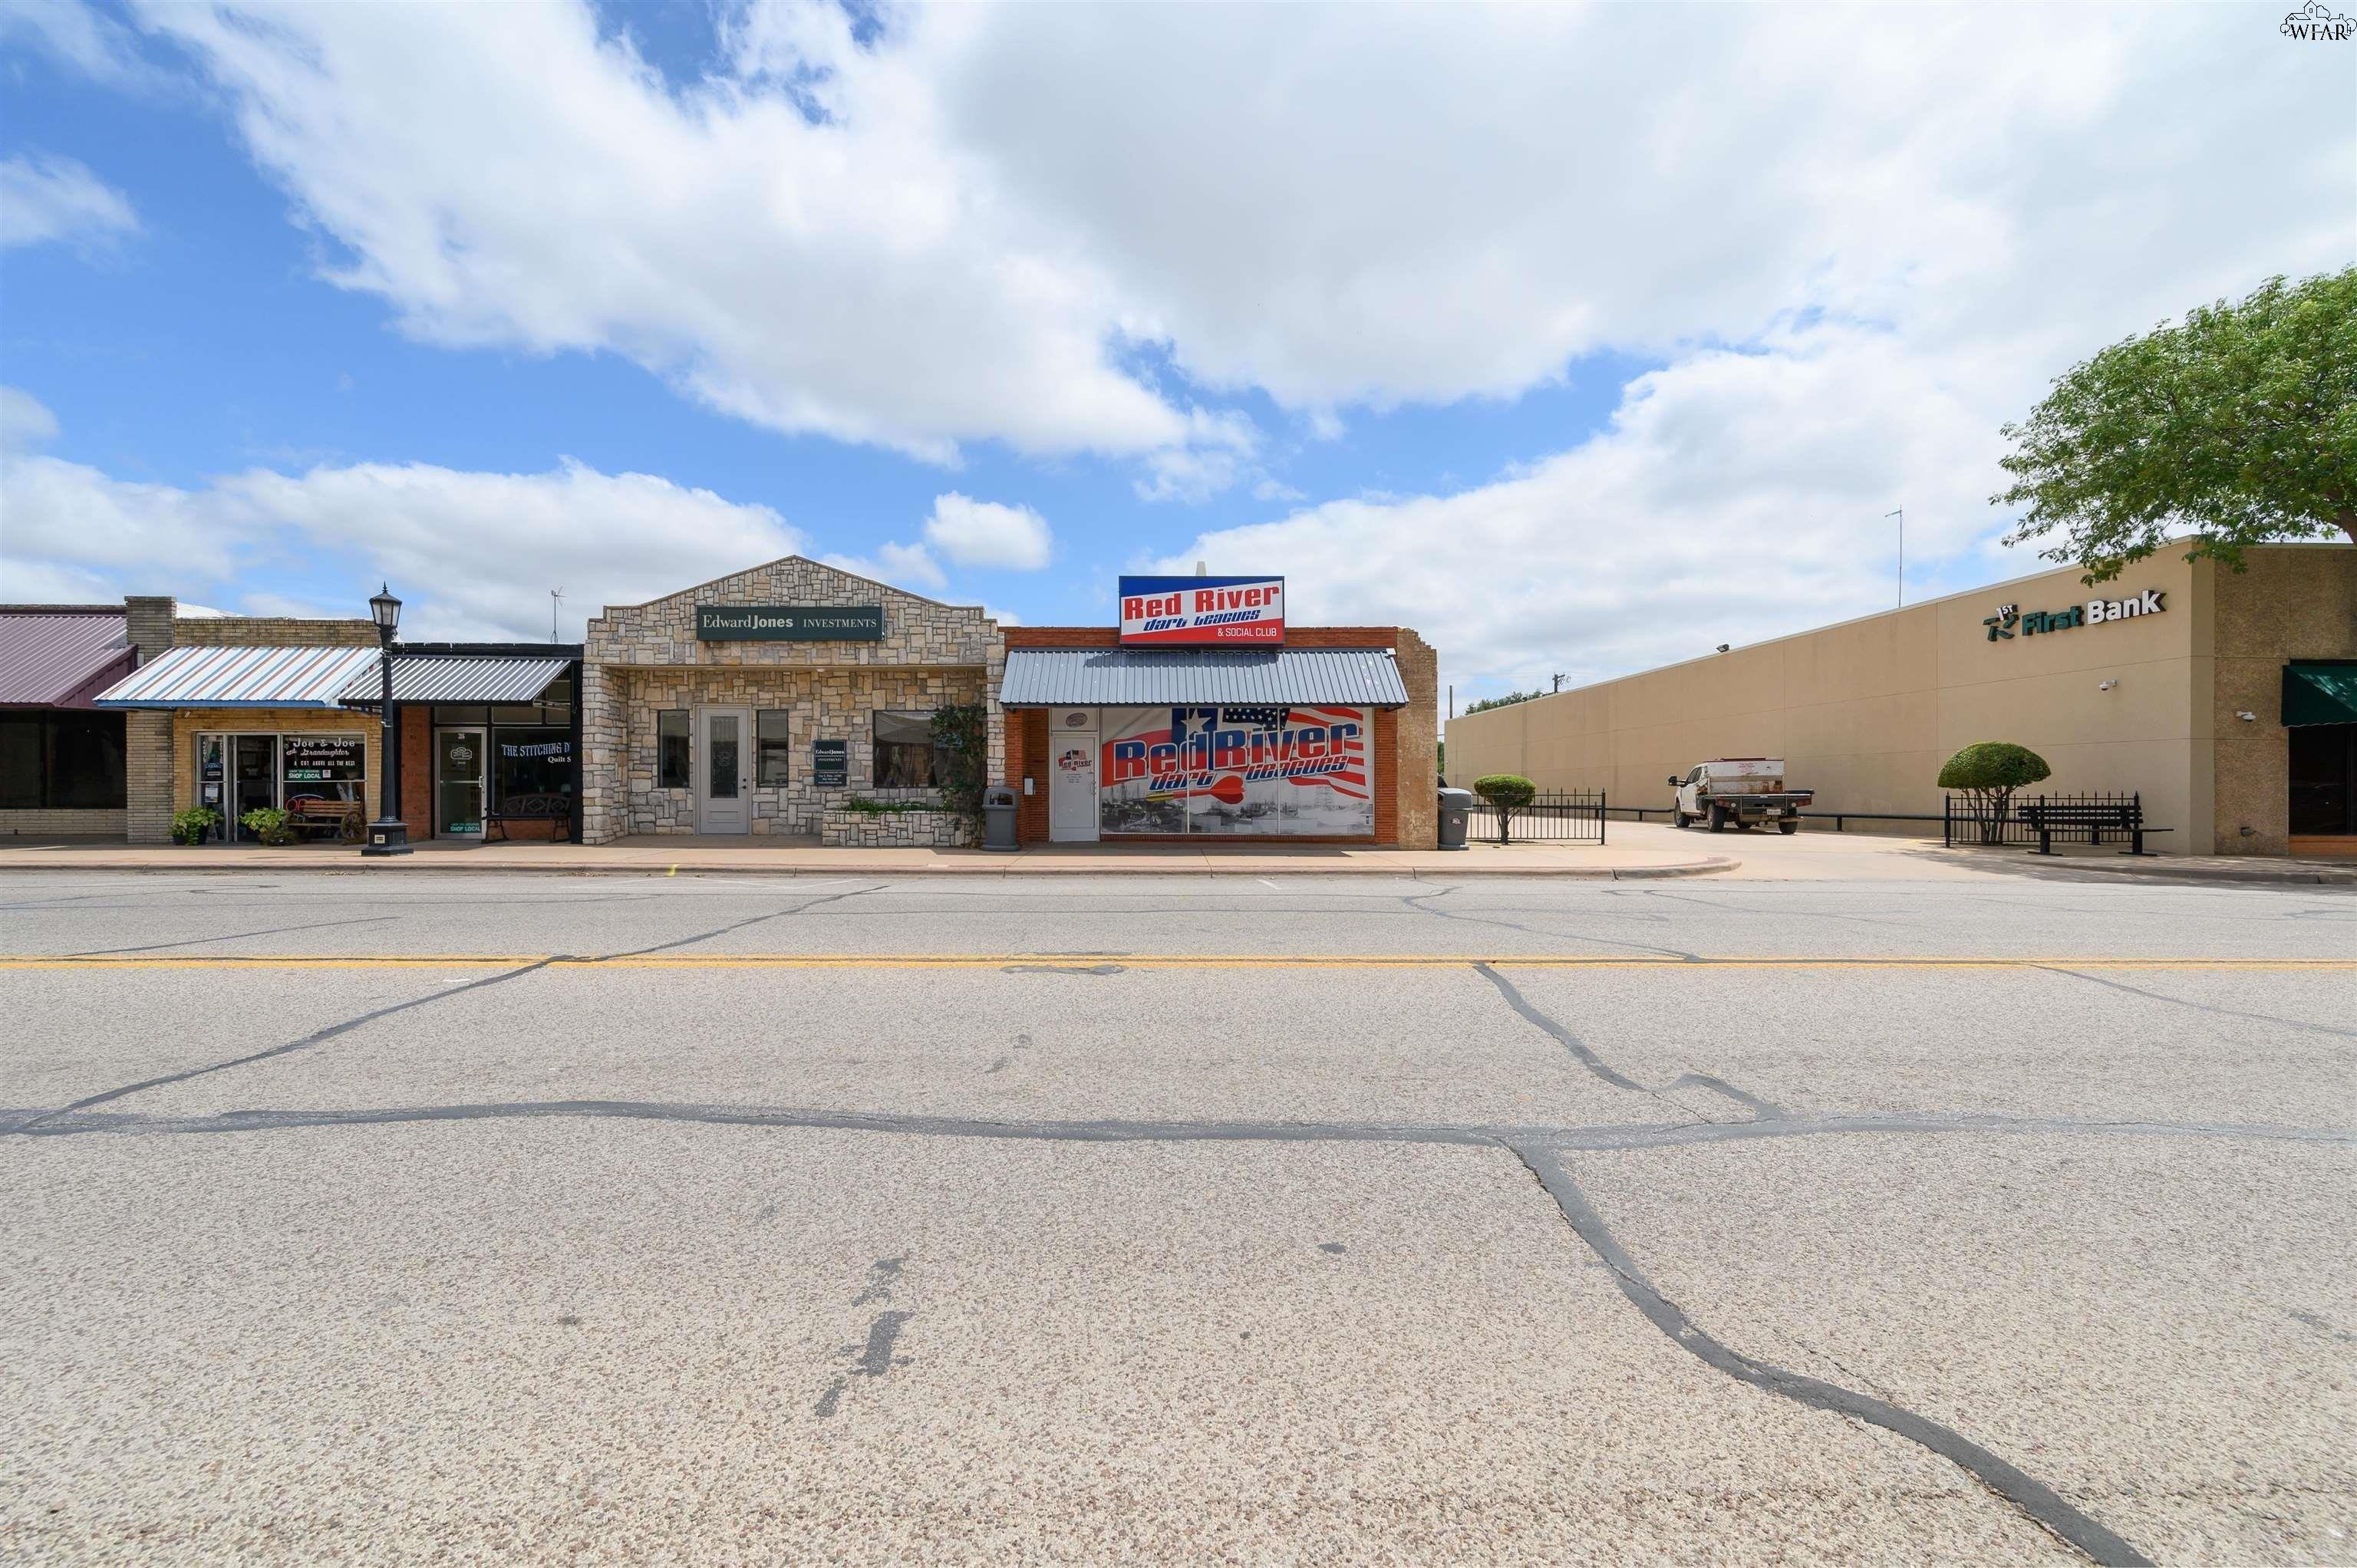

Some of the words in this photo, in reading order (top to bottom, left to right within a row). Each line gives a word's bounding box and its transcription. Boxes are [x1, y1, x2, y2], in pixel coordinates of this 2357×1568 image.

[1124, 593, 1182, 621] Red
[1195, 586, 1280, 613] River
[2022, 606, 2084, 636] First
[2087, 590, 2164, 624] Bank
[803, 618, 877, 628] INVESTMENTS
[1218, 628, 1225, 637] &
[1225, 628, 1254, 637] SOCIAL
[1255, 628, 1277, 636] CLUB
[293, 738, 315, 747] Joe
[320, 739, 328, 747] &
[334, 737, 355, 747] Joe
[501, 743, 518, 756] THE
[520, 743, 562, 756] STITCHING
